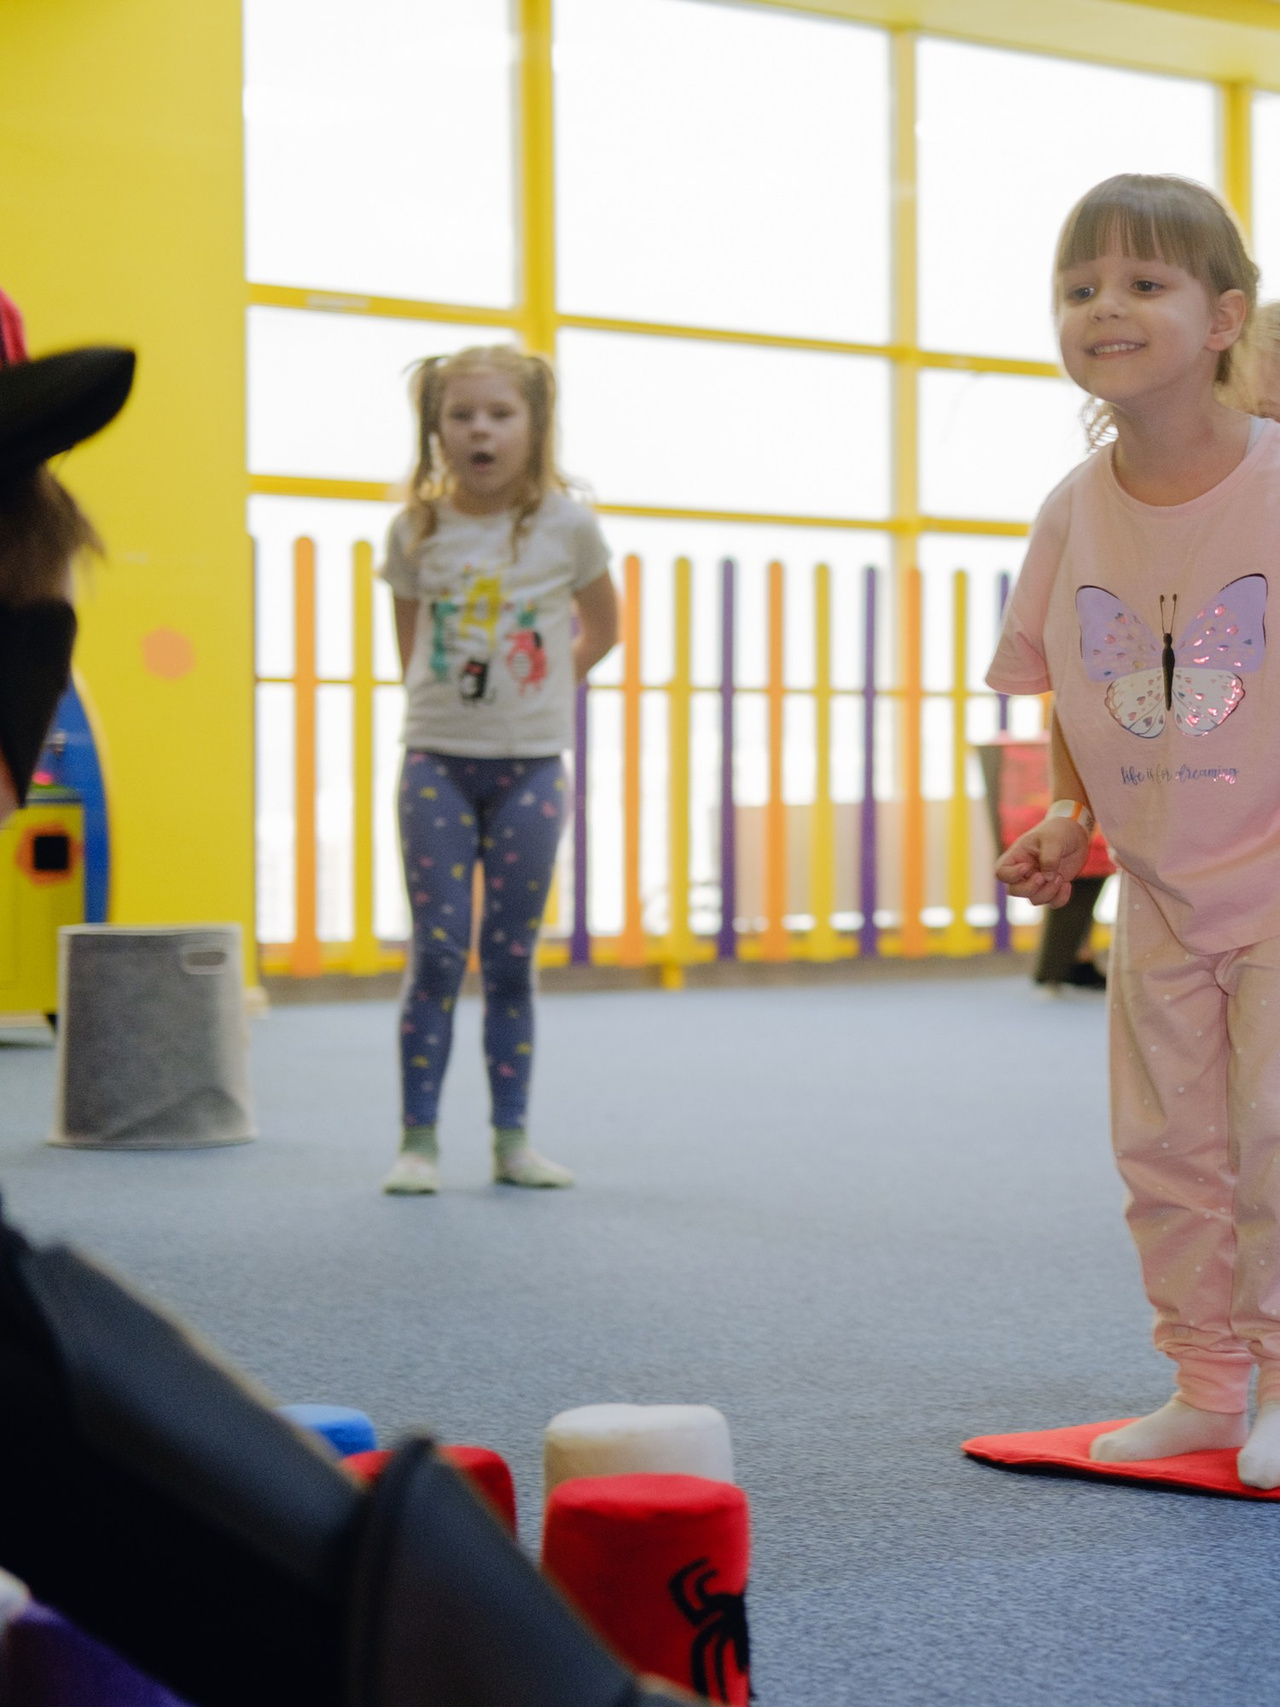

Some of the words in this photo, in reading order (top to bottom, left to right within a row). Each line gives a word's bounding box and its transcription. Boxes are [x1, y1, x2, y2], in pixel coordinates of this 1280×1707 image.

[1121, 766, 1144, 785] life
[1147, 768, 1154, 780] is
[1155, 764, 1172, 784] for
[1175, 764, 1238, 784] dreaming
